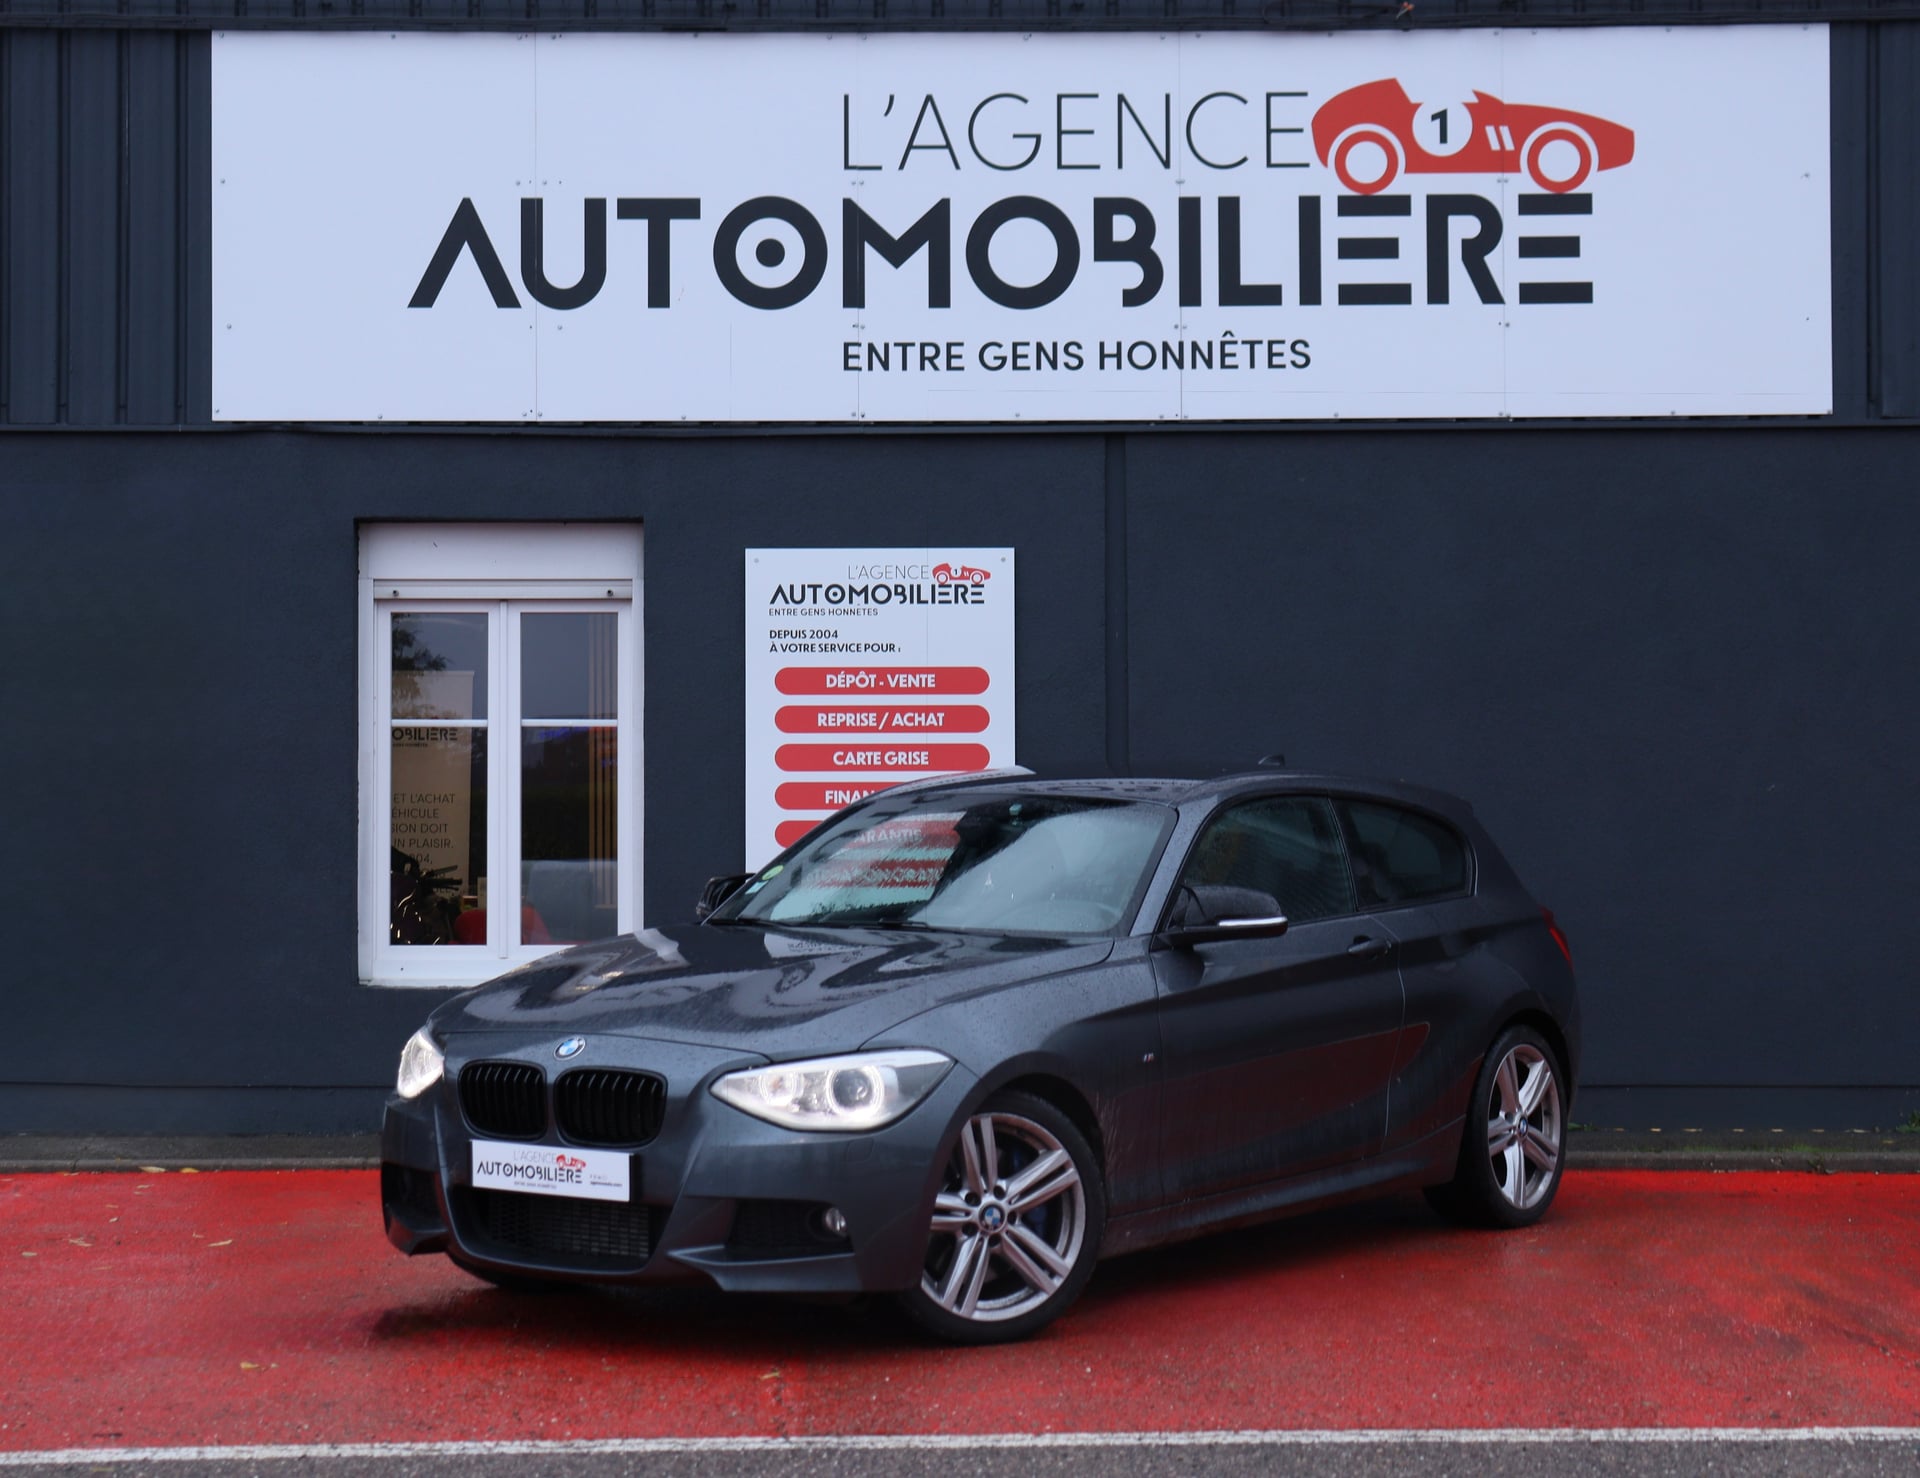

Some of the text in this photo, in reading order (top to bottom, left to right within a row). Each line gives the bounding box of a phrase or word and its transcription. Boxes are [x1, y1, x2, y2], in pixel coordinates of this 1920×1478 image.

[1430, 109, 1450, 144] 1
[407, 193, 1594, 311] AUTOMOBILIERE
[843, 330, 1312, 371] ENTRE GENS HONNÊTES
[769, 583, 985, 605] AUTOMOBILIERE
[768, 608, 798, 617] ENTRE
[800, 608, 826, 617] GENS
[769, 629, 839, 640] DEPUIS 2004
[769, 641, 778, 653] À
[780, 642, 817, 653] VOTRE
[818, 642, 862, 653] SERVICE
[864, 642, 896, 653] POUR
[826, 671, 876, 688] DÉPÔT
[887, 674, 936, 688] VENTE
[817, 712, 877, 727] REPRISE
[892, 712, 945, 727] ACHAT
[833, 751, 929, 766] CARTE GRISE
[394, 794, 406, 803] ET
[391, 807, 439, 819] ÉHICULE
[420, 823, 448, 833] DOIT
